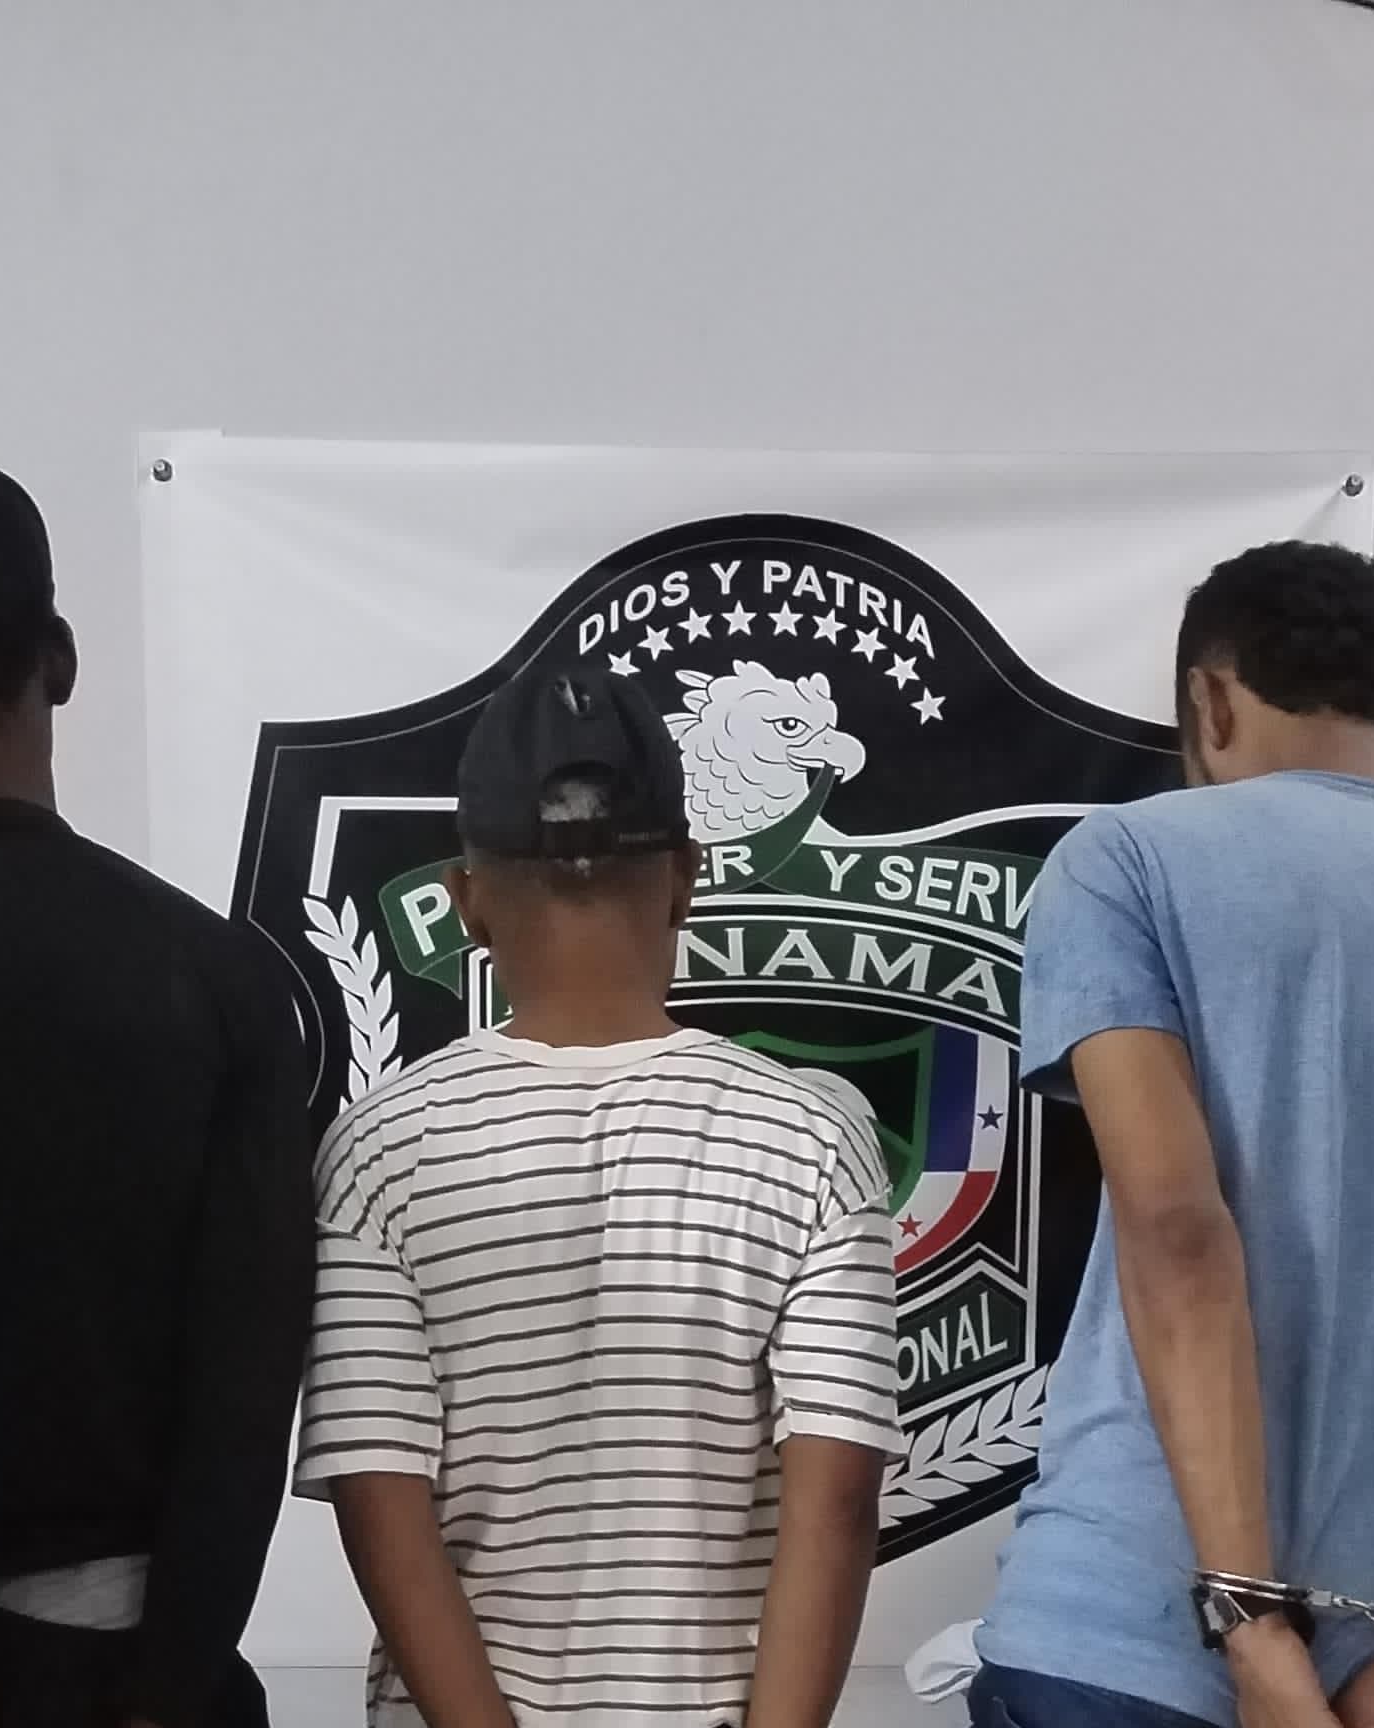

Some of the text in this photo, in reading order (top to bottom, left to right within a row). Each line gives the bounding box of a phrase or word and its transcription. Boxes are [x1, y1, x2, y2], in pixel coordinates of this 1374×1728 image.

[579, 560, 935, 660] DIOS Y PATRIA
[819, 849, 862, 893] Y
[874, 855, 1037, 931] SERV
[673, 926, 1009, 1018] NAMA
[896, 1291, 1009, 1392] ONAL
